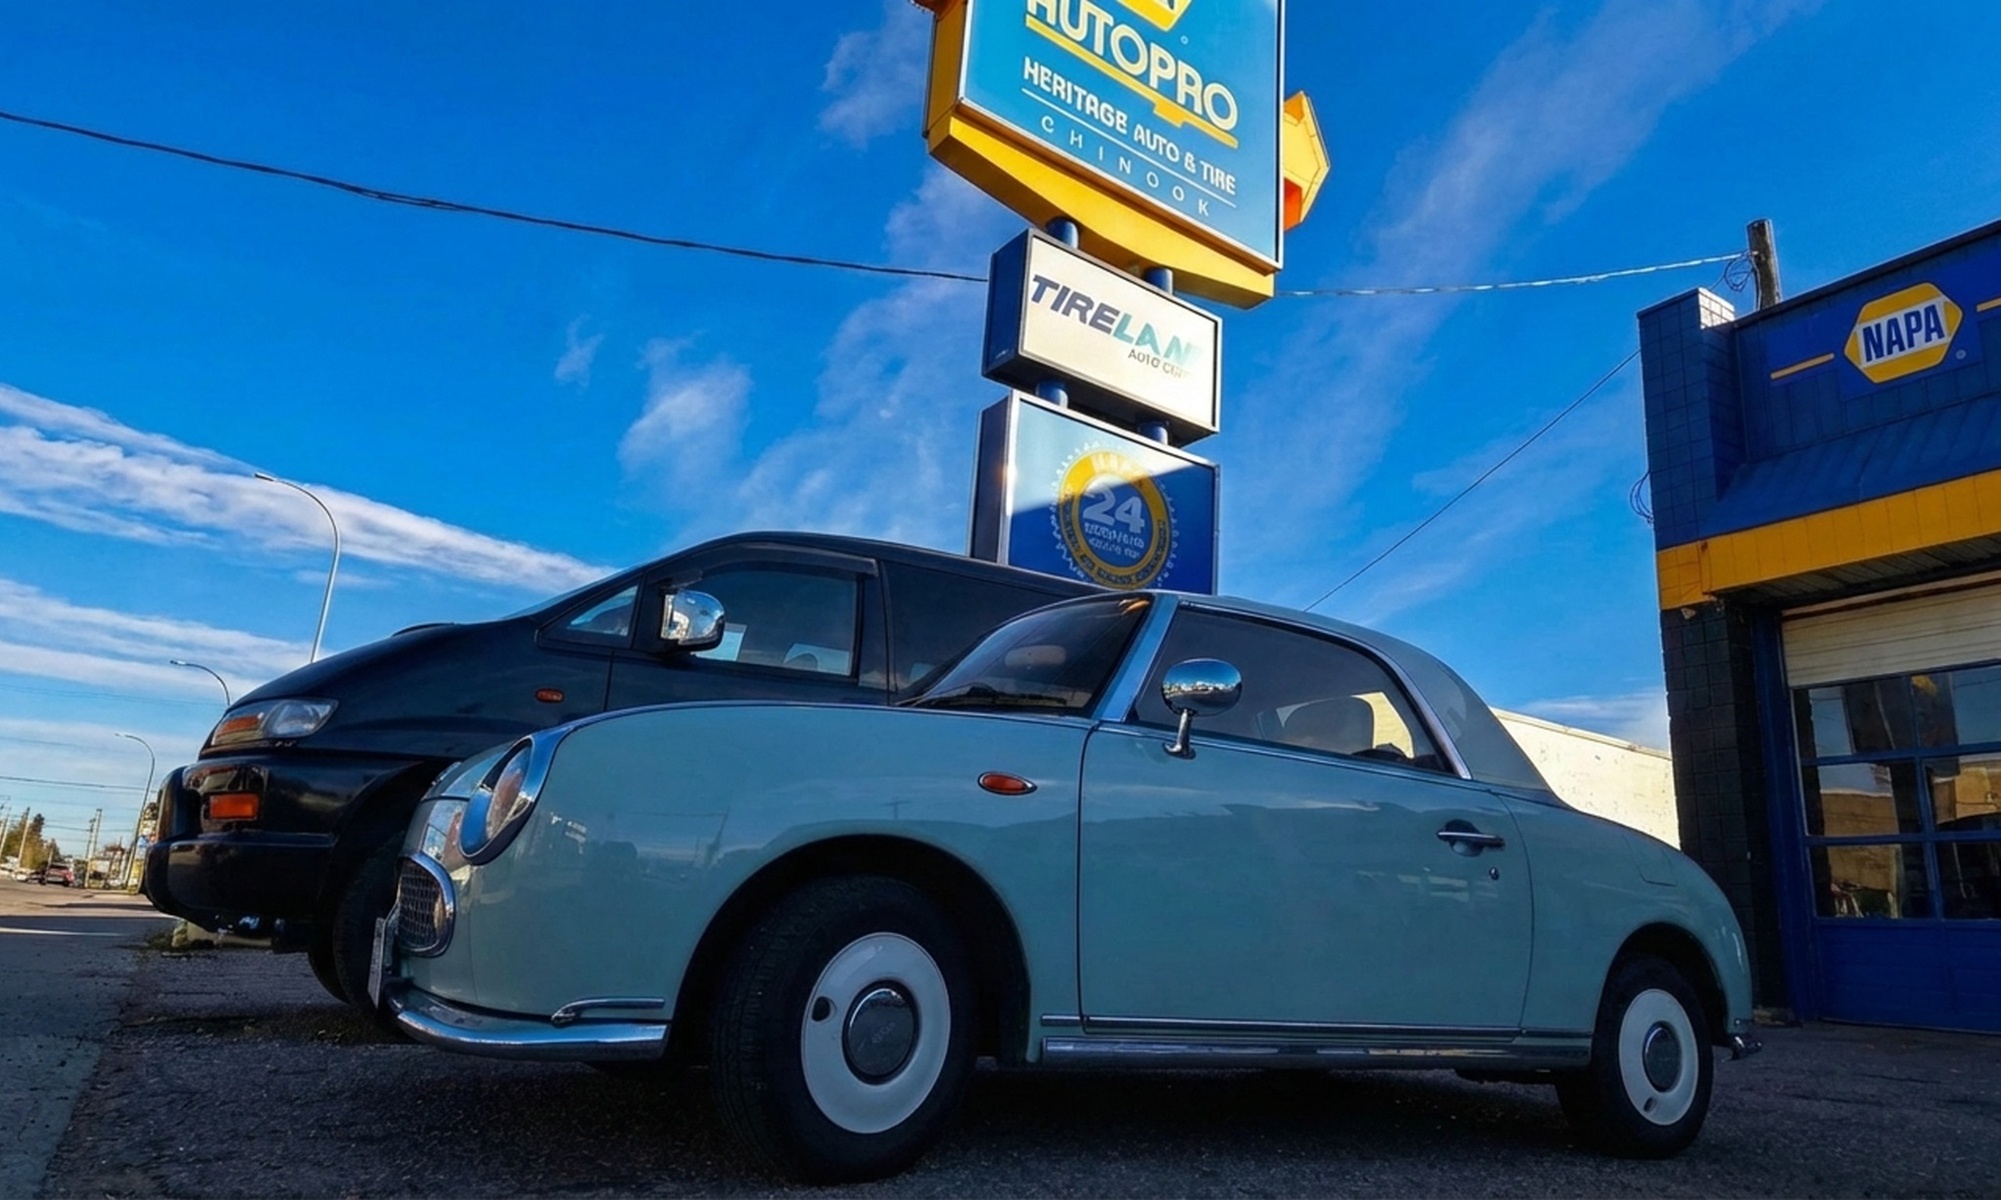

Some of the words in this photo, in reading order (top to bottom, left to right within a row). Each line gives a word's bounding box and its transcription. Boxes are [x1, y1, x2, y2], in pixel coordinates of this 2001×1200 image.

[1023, 56, 1128, 135] HERITAGE
[1134, 123, 1180, 163] AUTO
[1200, 160, 1236, 196] TIRE
[1041, 115, 1209, 217] CHINOOK
[1861, 303, 1945, 363] NAPA
[1082, 482, 1145, 534] 24
